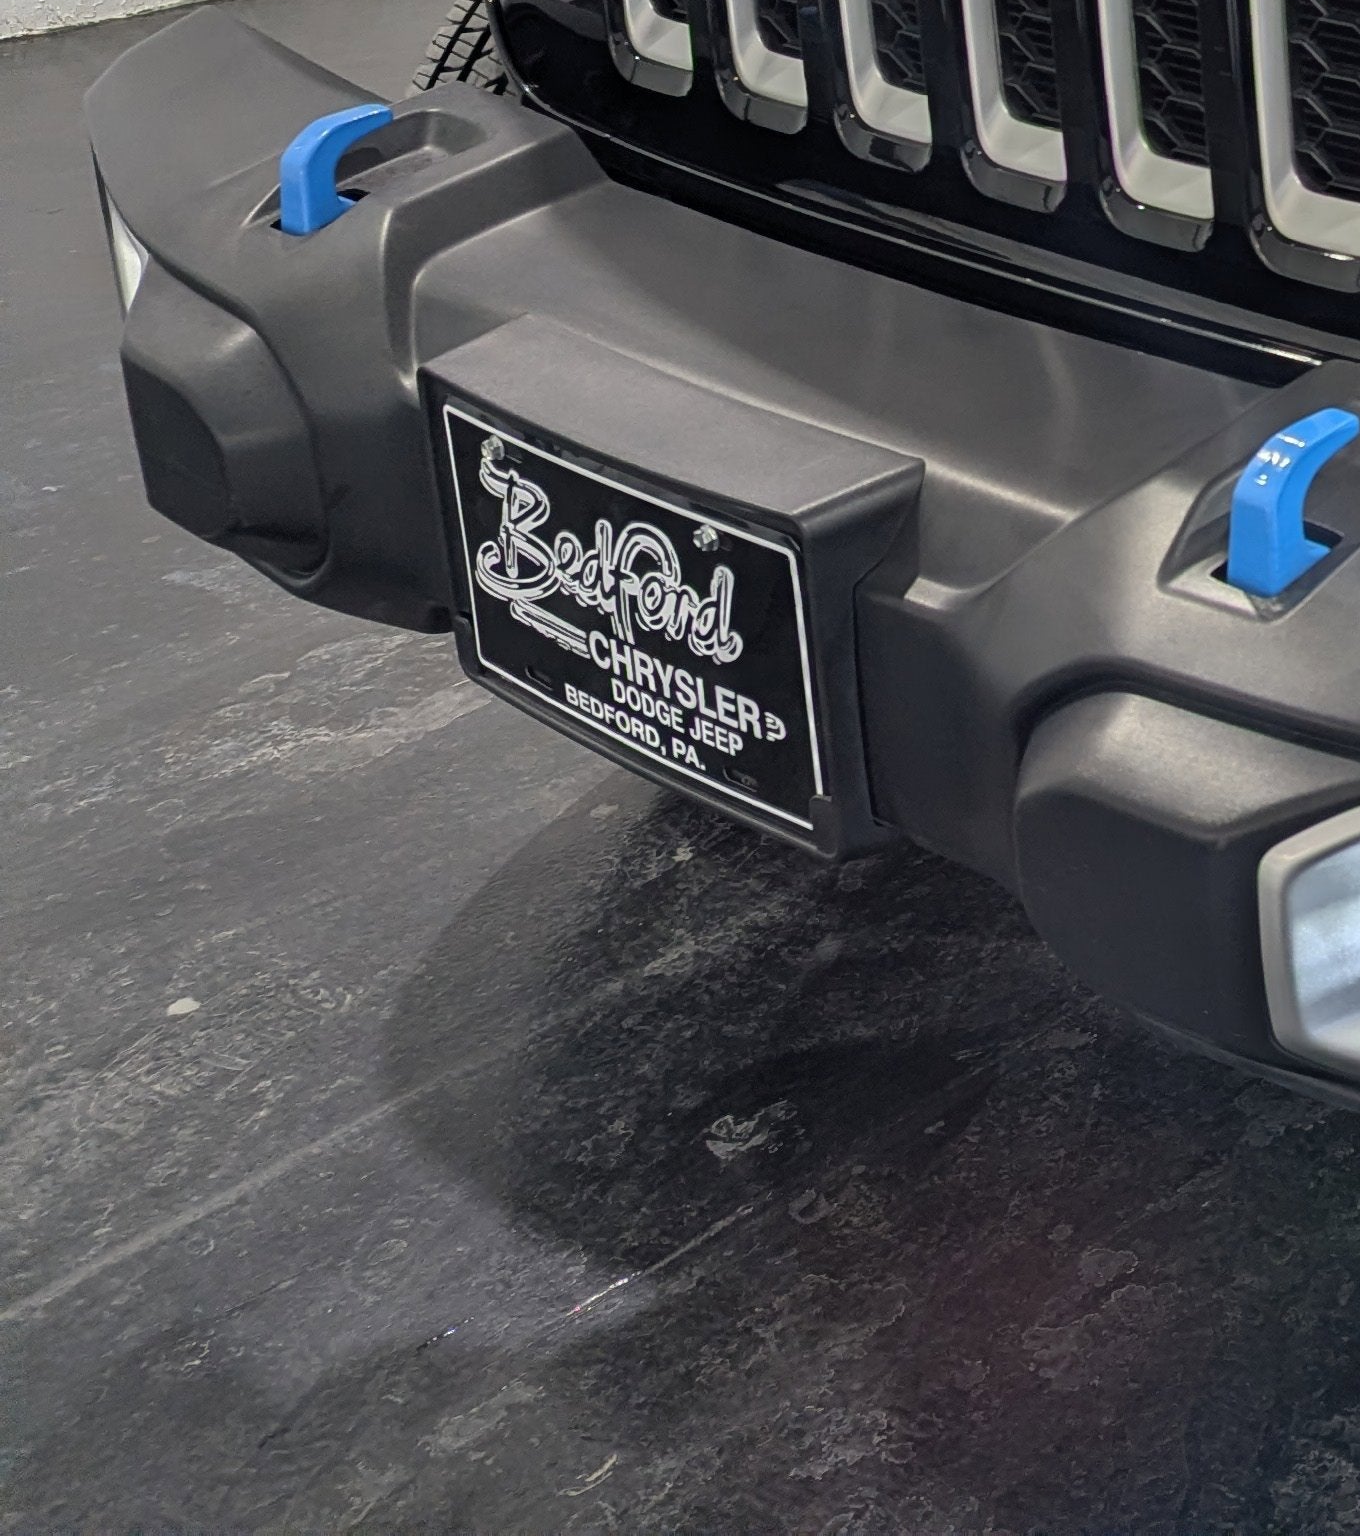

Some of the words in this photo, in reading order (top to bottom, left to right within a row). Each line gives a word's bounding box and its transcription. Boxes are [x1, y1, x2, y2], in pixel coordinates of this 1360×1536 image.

[475, 457, 744, 665] Bedford
[563, 682, 667, 756] BEDFORD,
[671, 736, 707, 771] PA.
[588, 630, 763, 740] CHRYSLER
[610, 677, 685, 734] DODGE
[689, 716, 744, 757] JEEP
